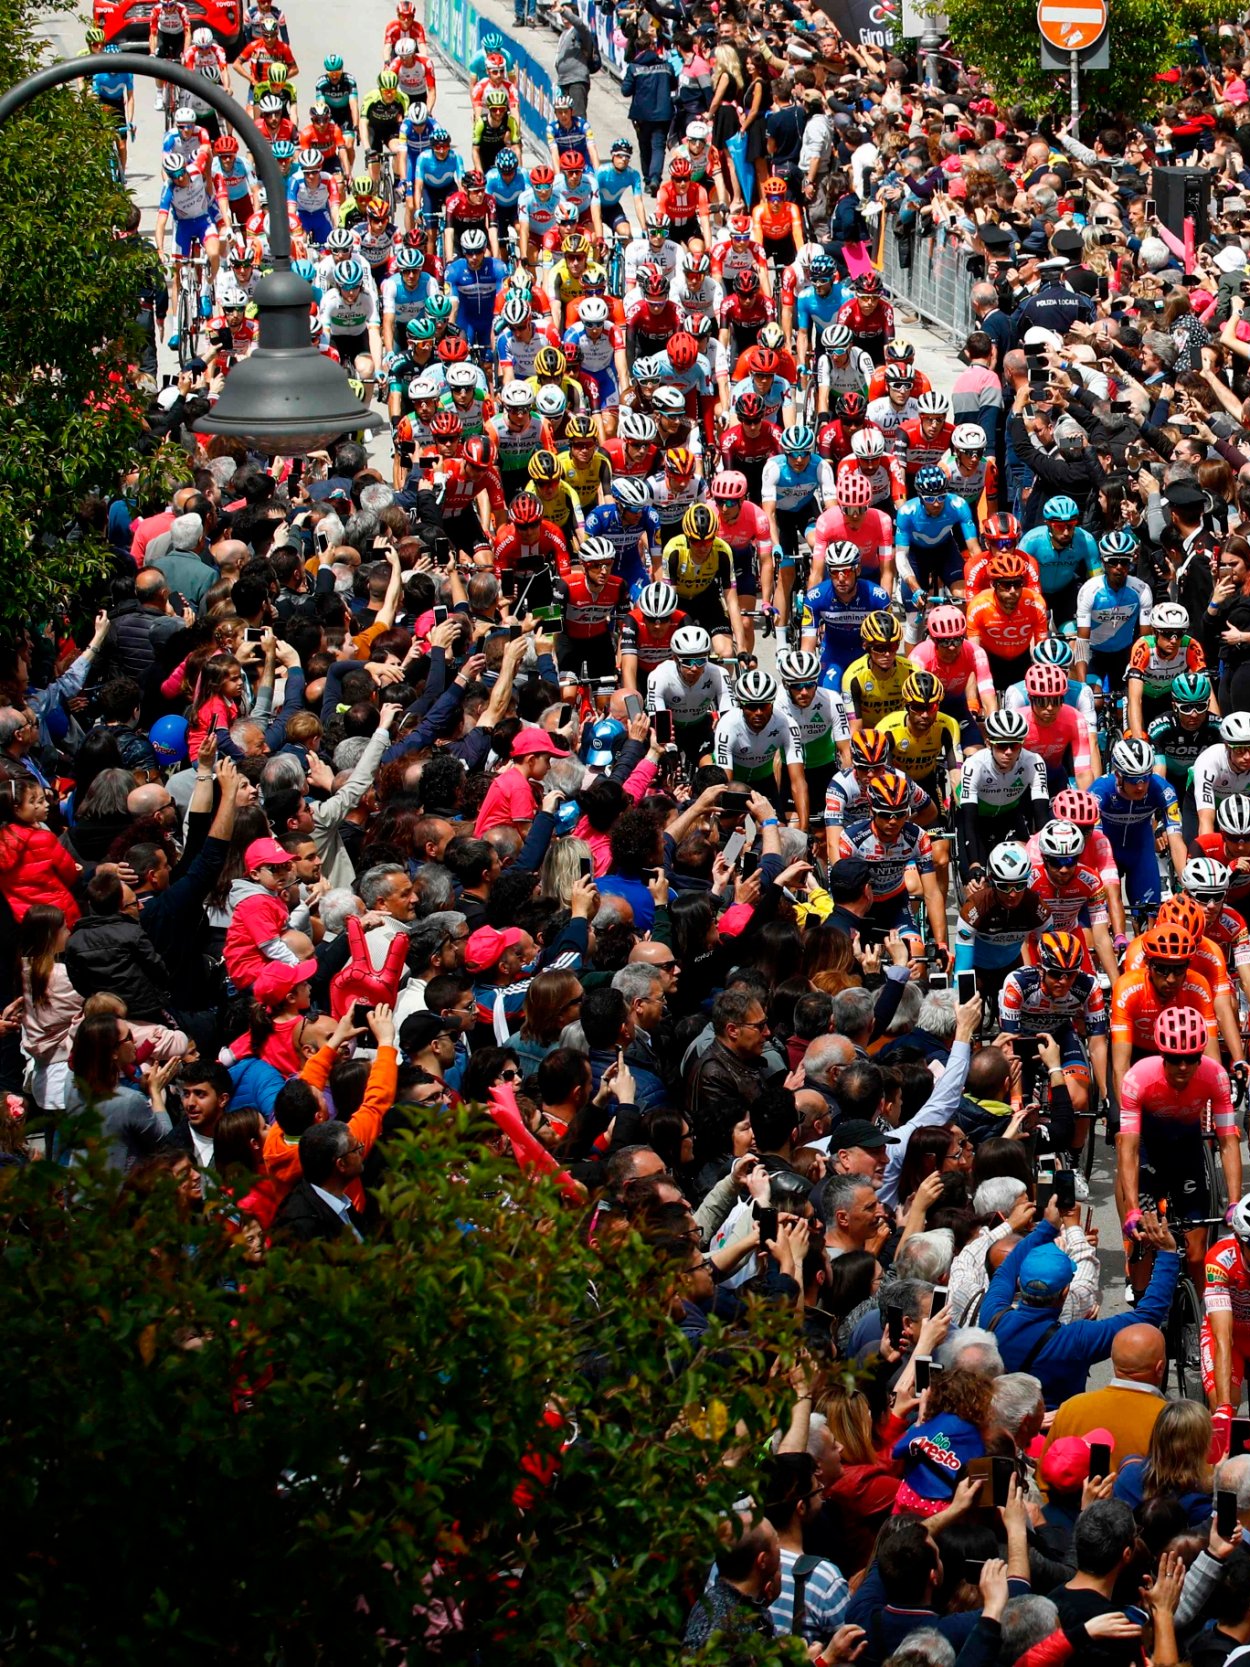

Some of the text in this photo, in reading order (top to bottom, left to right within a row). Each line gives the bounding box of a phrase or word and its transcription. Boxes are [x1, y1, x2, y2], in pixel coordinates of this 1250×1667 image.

[644, 257, 667, 267] UAE
[1036, 299, 1057, 307] POLIZIA
[986, 624, 1032, 638] CCC
[835, 702, 849, 735] BMC
[718, 732, 730, 766] BMC
[961, 765, 974, 800] BMC
[1034, 761, 1048, 795] BMC
[1203, 770, 1216, 805] BMC
